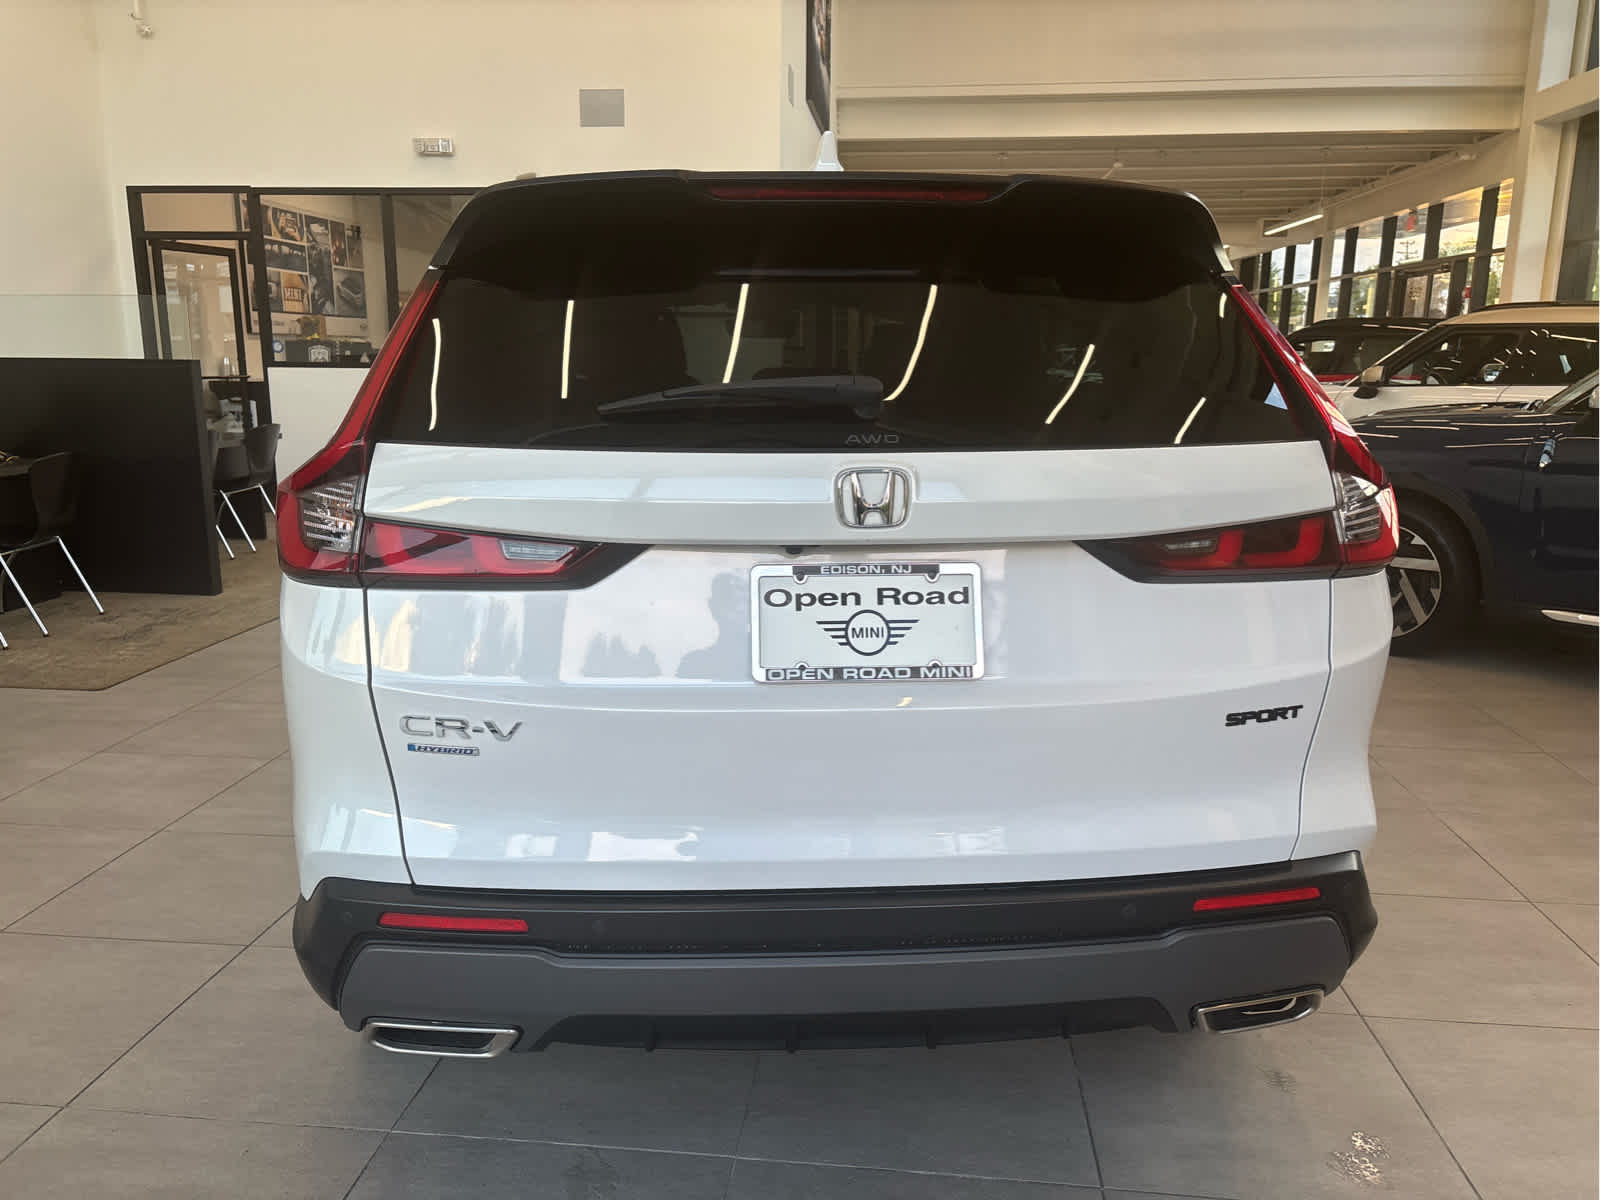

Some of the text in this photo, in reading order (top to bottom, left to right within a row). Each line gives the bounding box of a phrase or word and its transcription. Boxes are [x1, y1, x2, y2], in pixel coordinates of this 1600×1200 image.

[845, 433, 899, 445] AWD
[820, 564, 912, 574] EDISON, NJ
[764, 587, 970, 611] Open Road
[851, 627, 884, 639] MINI
[767, 666, 972, 680] OPEN ROAD MINI
[1225, 705, 1303, 726] SPORT
[400, 715, 522, 741] CR-V
[415, 745, 474, 755] HYBRID
